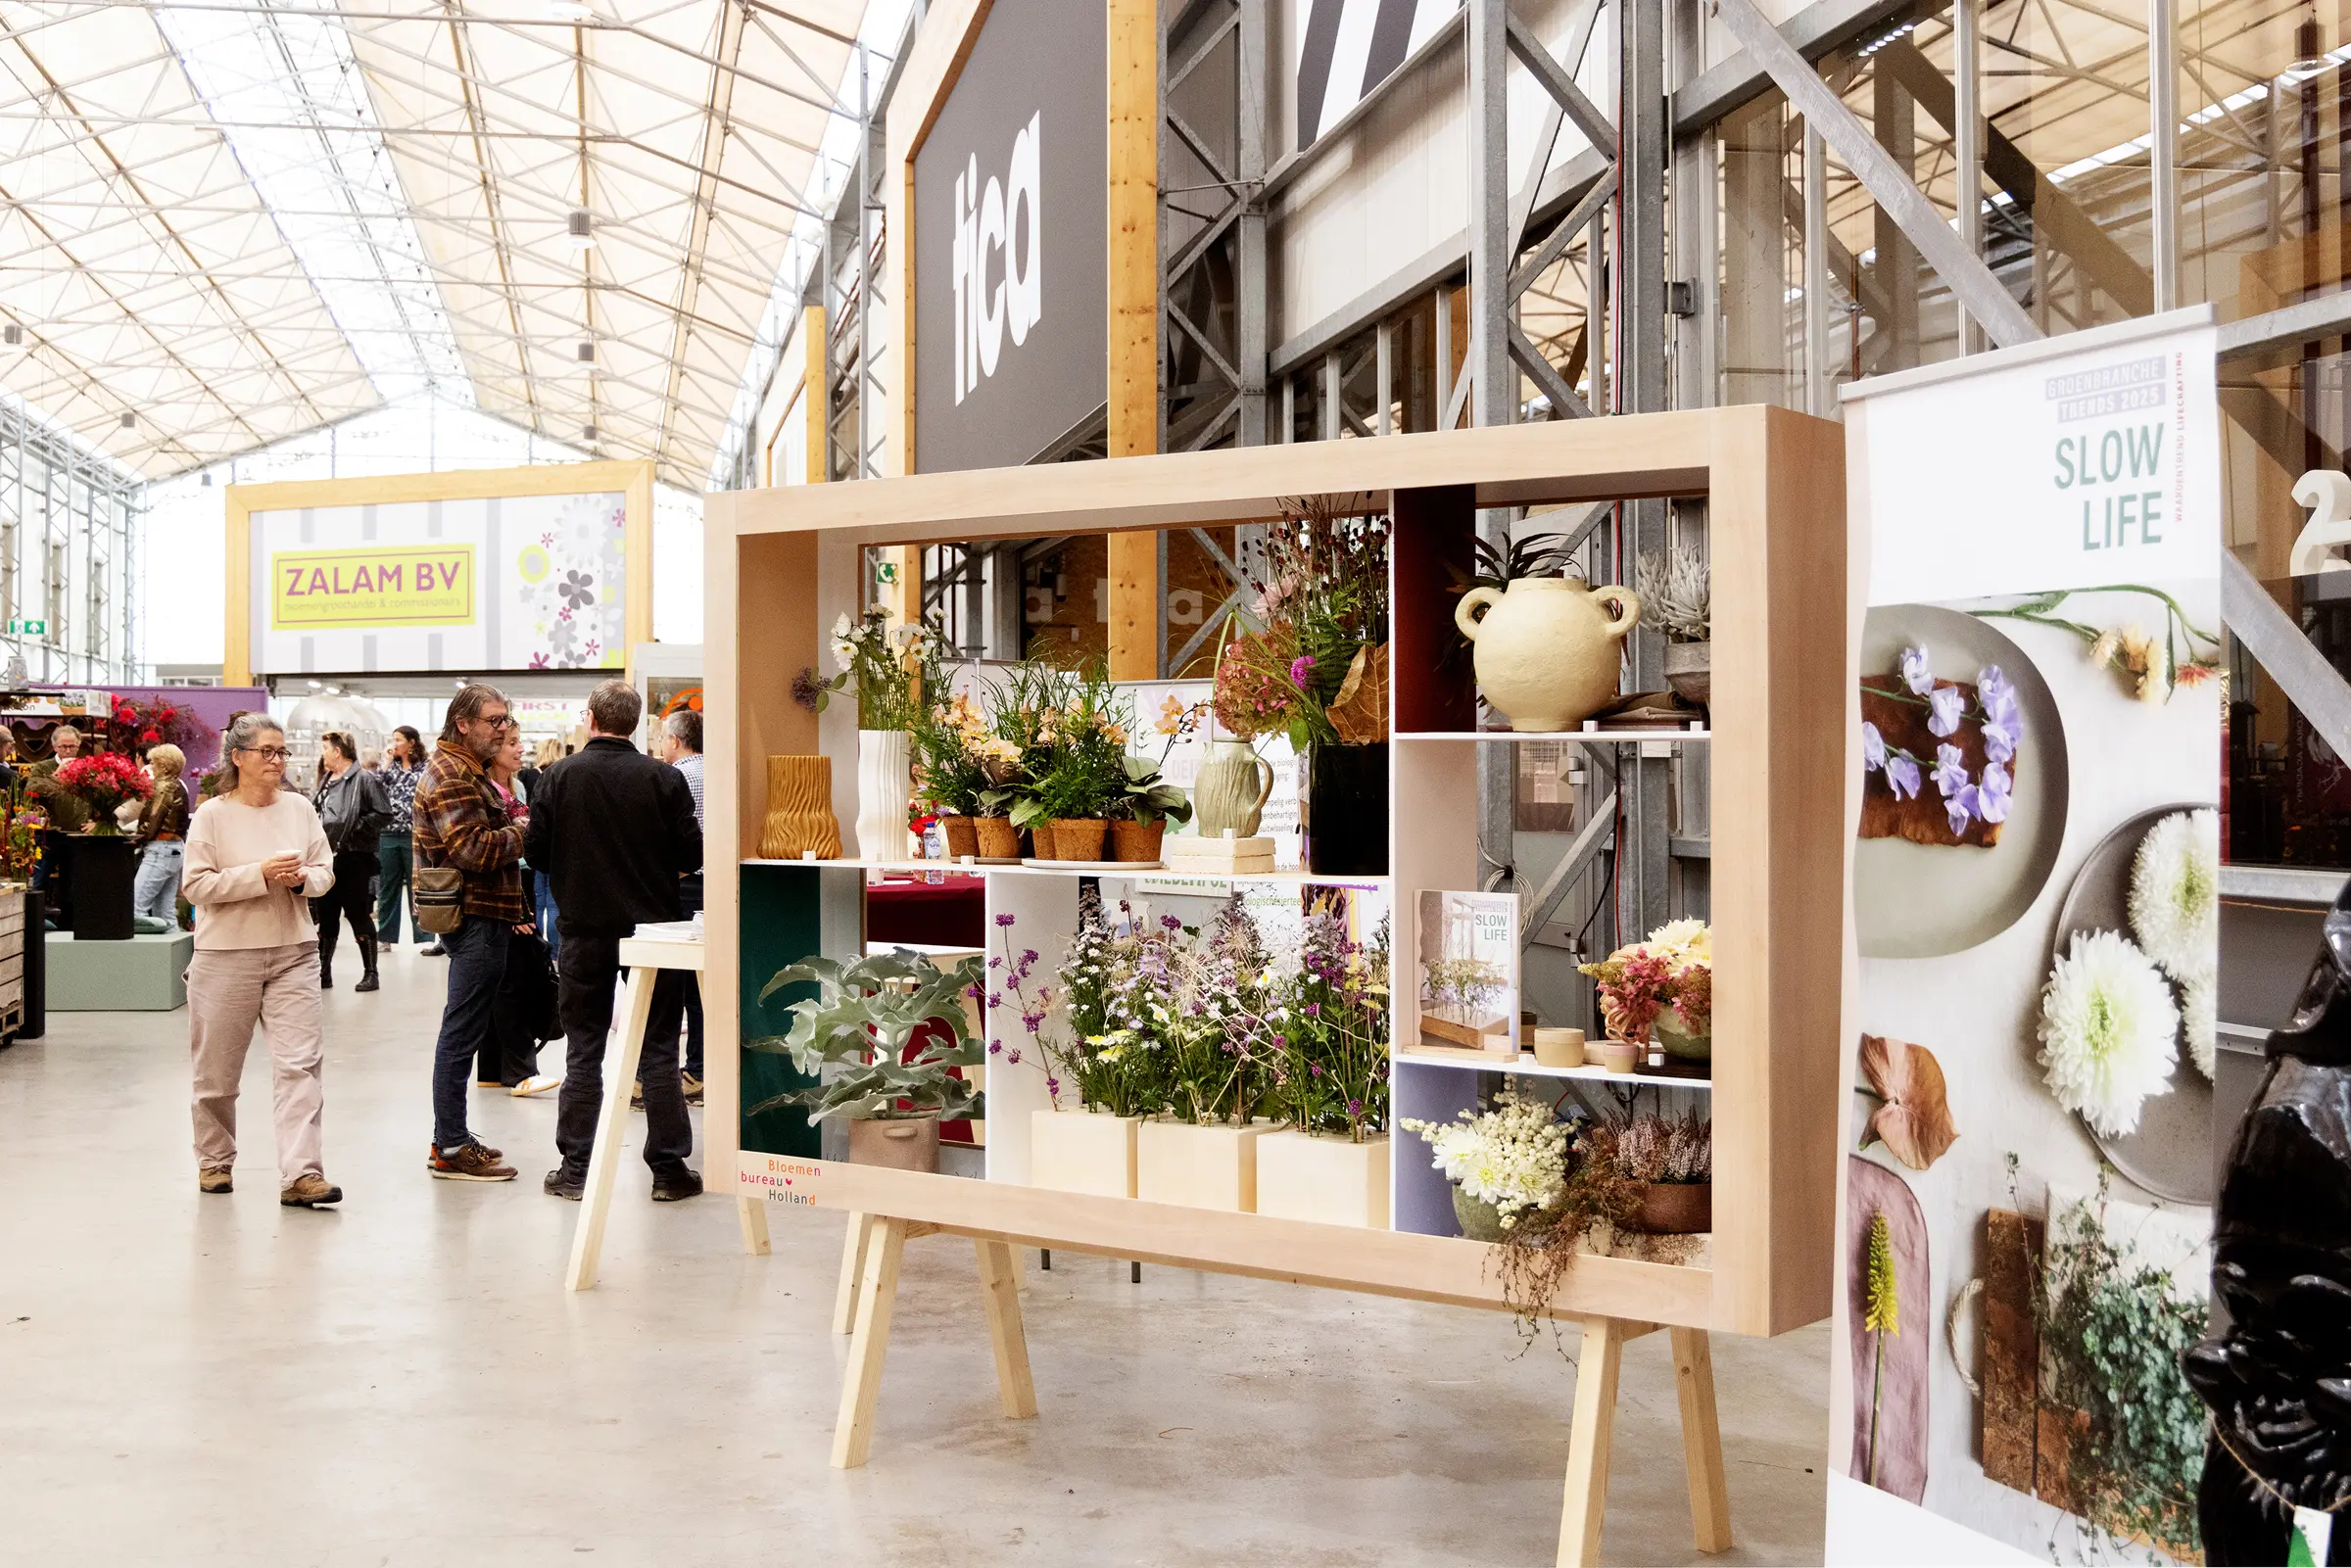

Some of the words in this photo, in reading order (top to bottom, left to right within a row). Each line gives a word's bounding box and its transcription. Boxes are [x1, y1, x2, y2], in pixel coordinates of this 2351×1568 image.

[2047, 358, 2161, 399] GROENBRANCHE
[2176, 352, 2185, 431] LIFECRAFTING
[2060, 394, 2116, 421] TRENDS
[2121, 387, 2160, 410] 2025
[2053, 422, 2165, 490] SLOW
[2083, 491, 2162, 551] LIFE
[285, 564, 403, 596] ZALAM
[415, 561, 460, 592] BV
[1475, 914, 1508, 927] SLOW
[1484, 928, 1508, 941] LIFE
[741, 1170, 783, 1187] bureau
[768, 1159, 821, 1176] Bloemen
[768, 1188, 816, 1206] Holland
